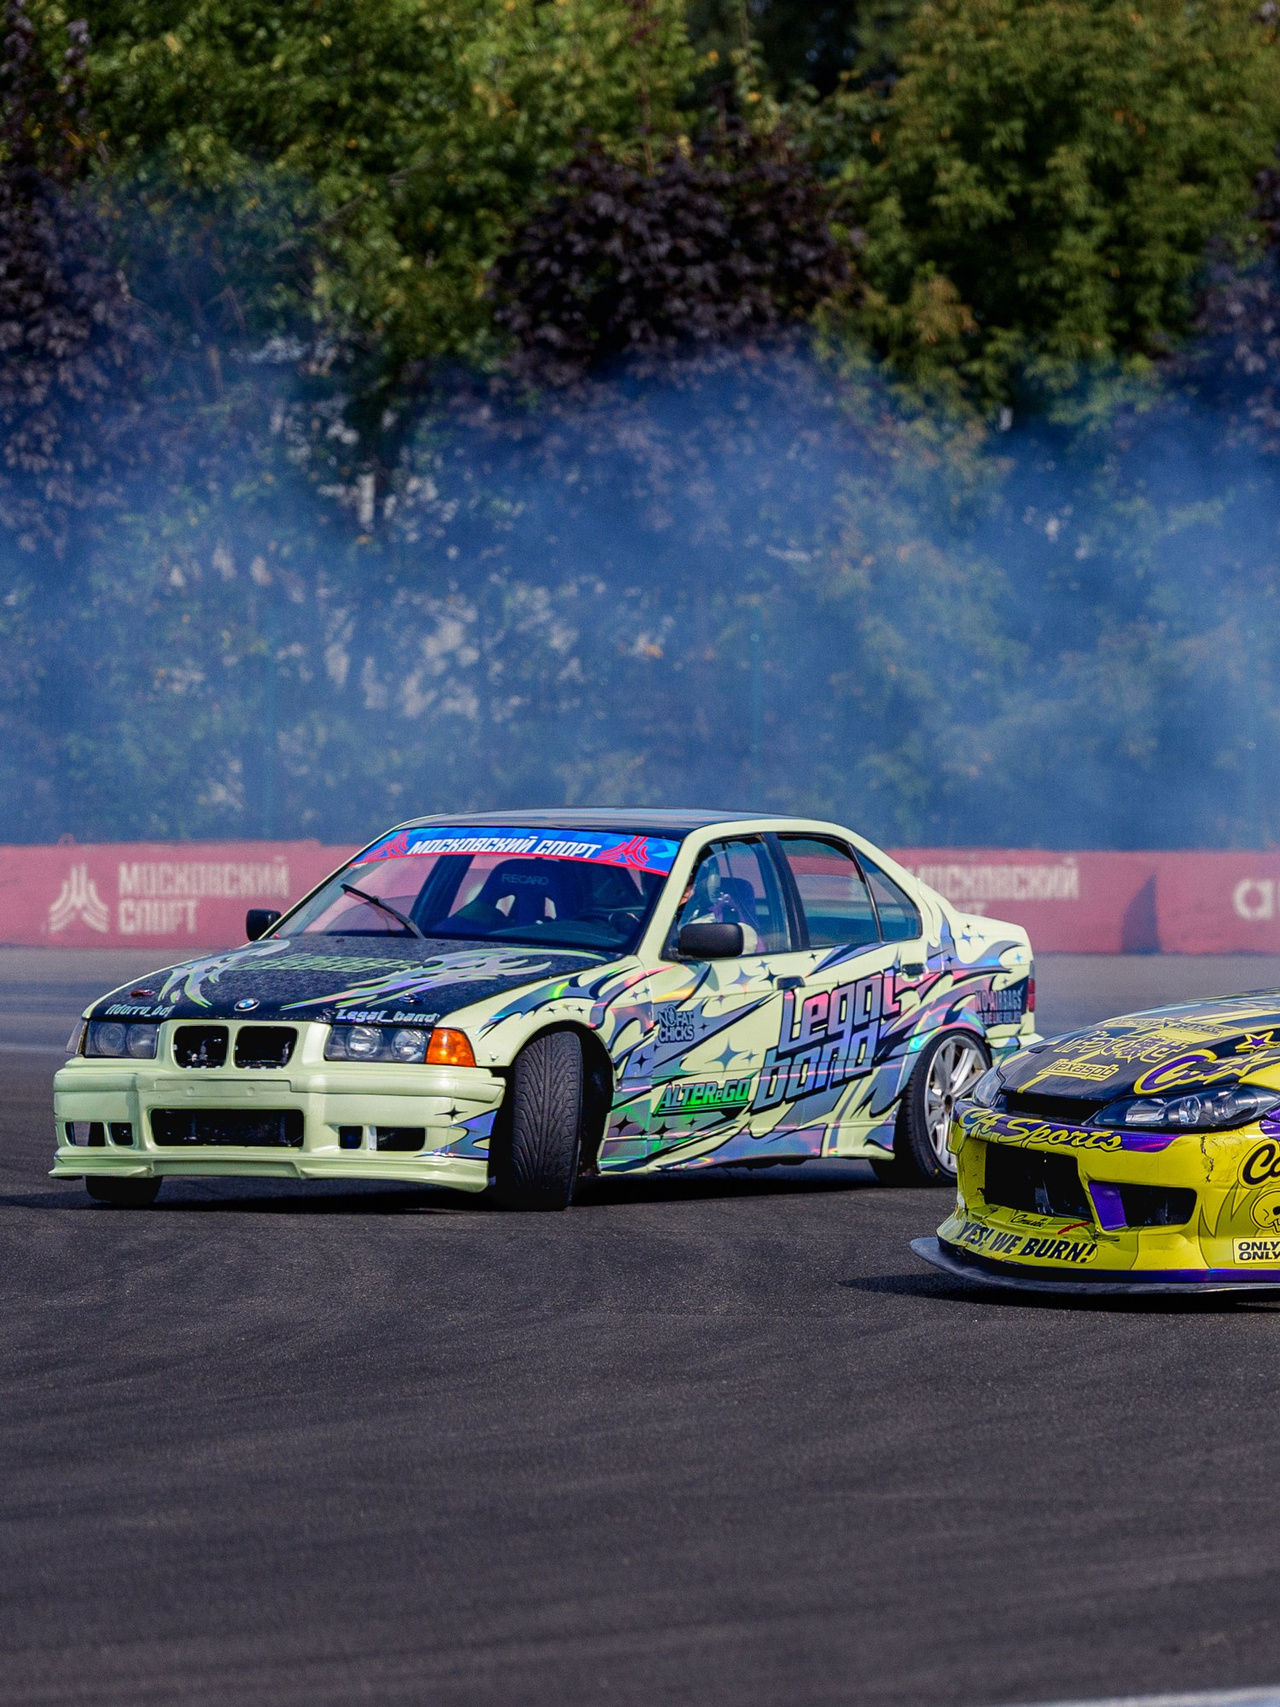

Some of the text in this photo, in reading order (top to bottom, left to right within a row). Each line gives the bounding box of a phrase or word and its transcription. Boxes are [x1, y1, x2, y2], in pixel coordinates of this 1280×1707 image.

[407, 836, 602, 858] МОСКОВСКИЙ СПОРТ
[118, 857, 290, 898] МОСКОВСКИЙ
[501, 873, 549, 886] RECARO
[658, 1005, 694, 1027] NO FAT
[659, 1025, 694, 1042] CHICKS
[998, 1118, 1123, 1151] Sports
[956, 1222, 1098, 1263] YES! WE BURN!
[1238, 1242, 1280, 1251] ONLY
